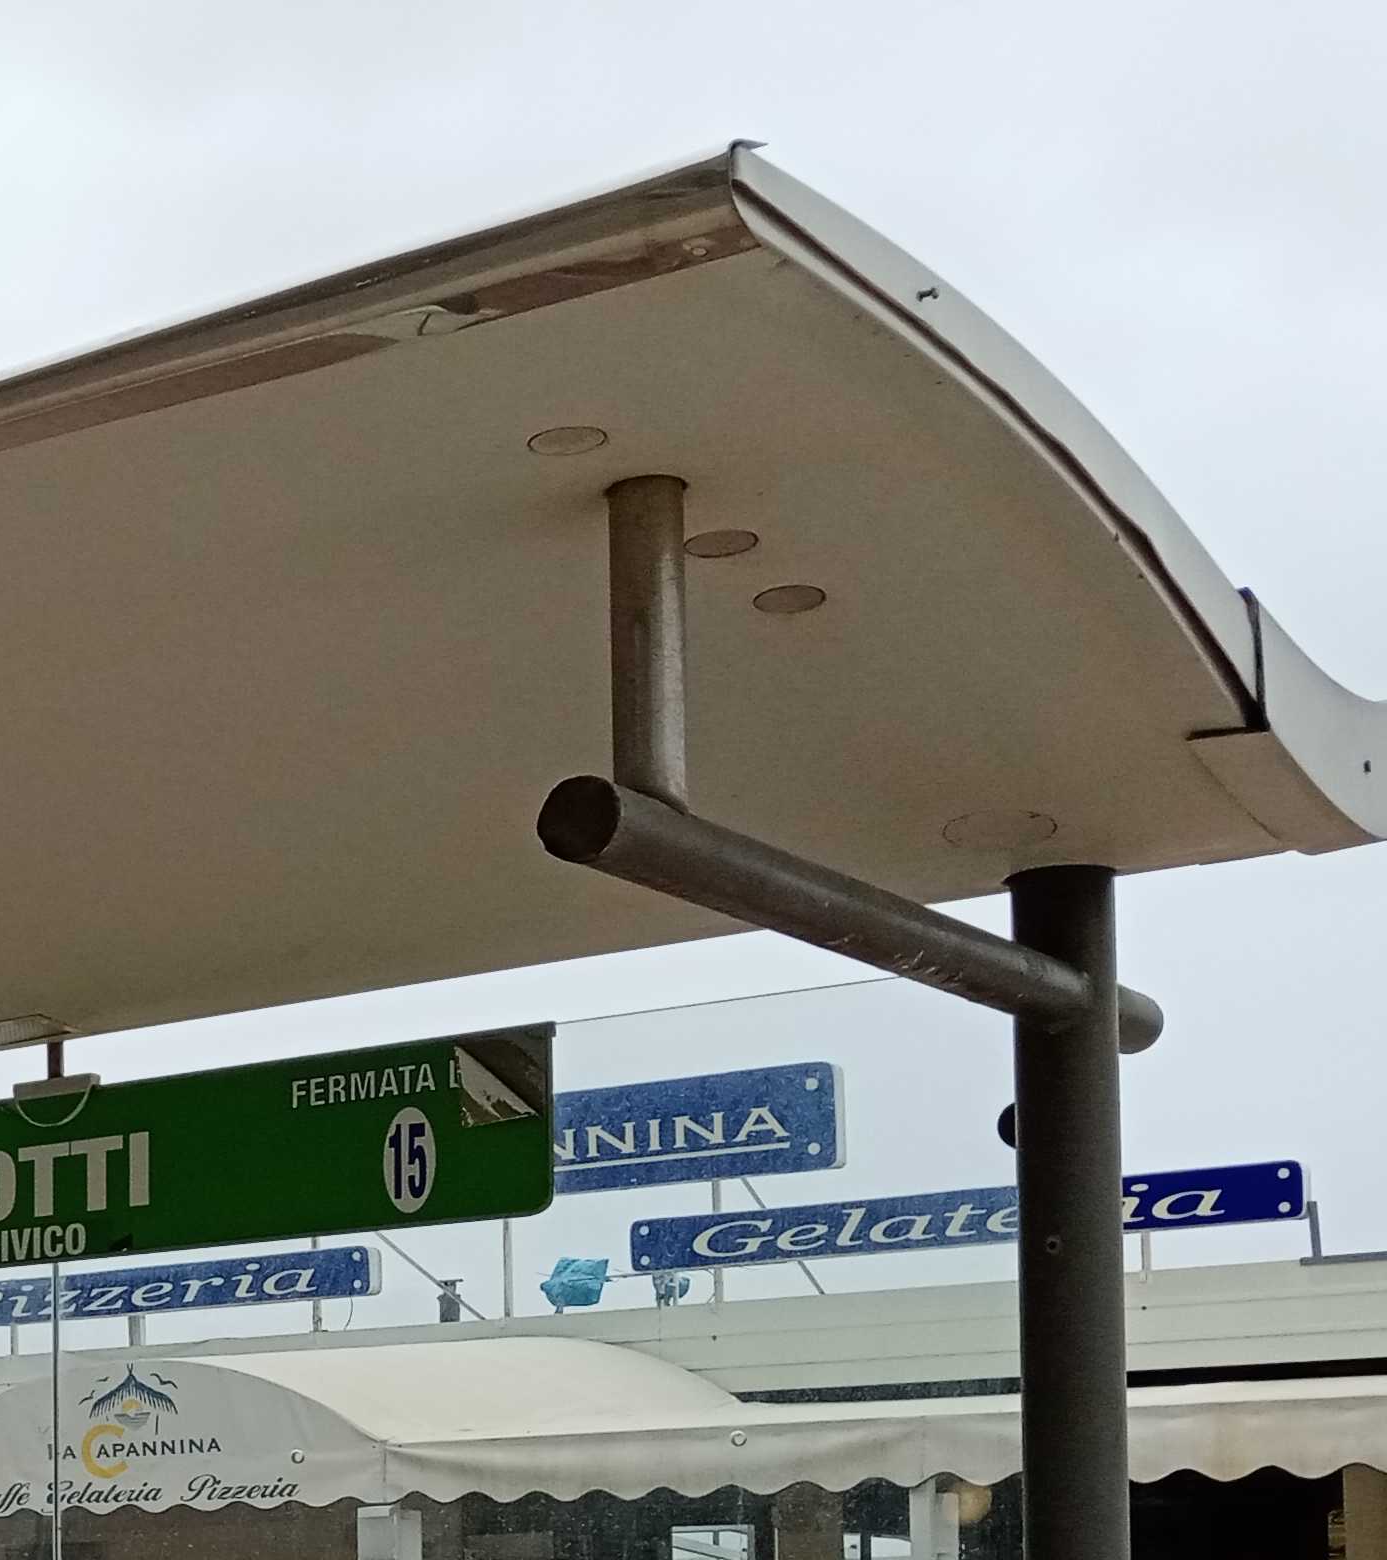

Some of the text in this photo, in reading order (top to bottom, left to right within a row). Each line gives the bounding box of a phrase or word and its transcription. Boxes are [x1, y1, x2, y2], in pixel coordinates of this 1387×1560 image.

[291, 1063, 436, 1109] FERMATA
[388, 1122, 427, 1200] 15
[691, 1183, 1227, 1259] Gelateia
[179, 1474, 300, 1503] Pizzeria
